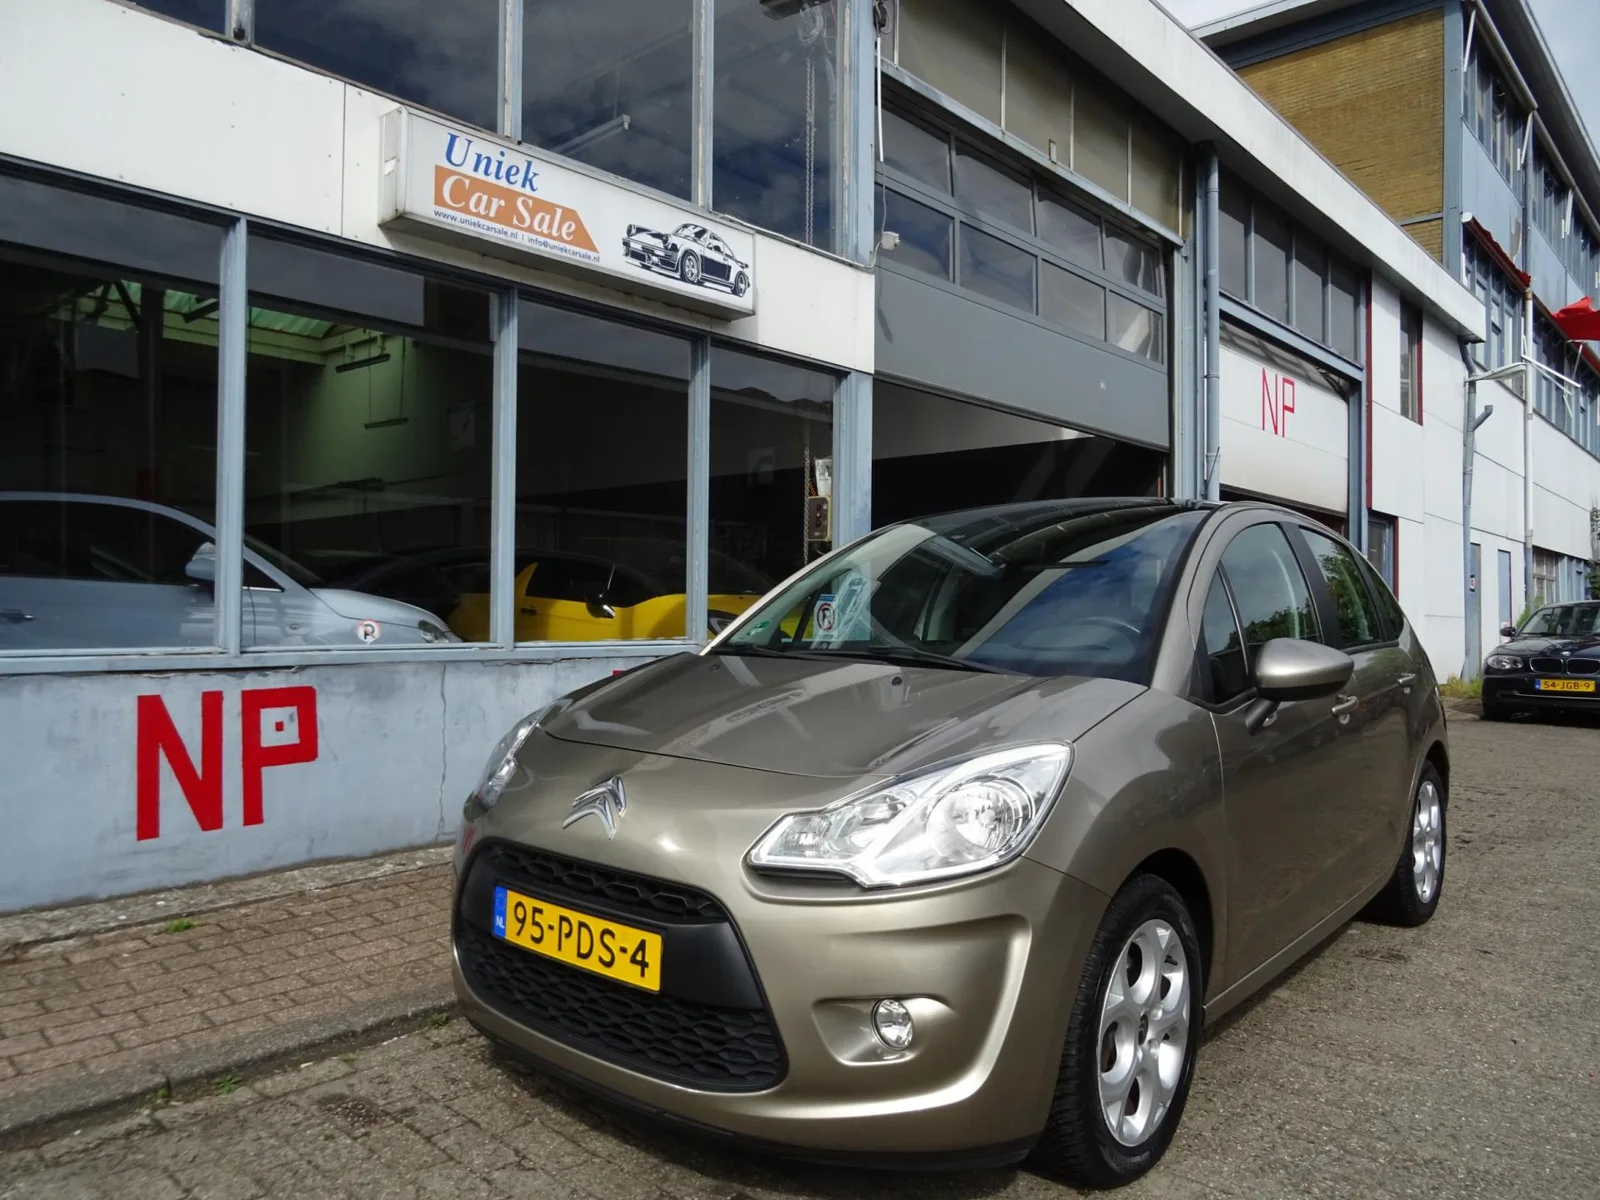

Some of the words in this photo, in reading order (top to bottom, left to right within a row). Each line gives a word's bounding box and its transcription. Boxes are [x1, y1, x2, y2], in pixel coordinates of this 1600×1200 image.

[445, 132, 540, 192] Uniek
[433, 209, 518, 240] www.uniekcarsale.nl
[528, 235, 600, 263] info@uniekcarsale.nl
[442, 174, 506, 218] Car
[512, 196, 576, 241] Sale
[1262, 367, 1295, 438] NP
[495, 914, 505, 930] NL
[513, 900, 650, 979] 95-PDS-4
